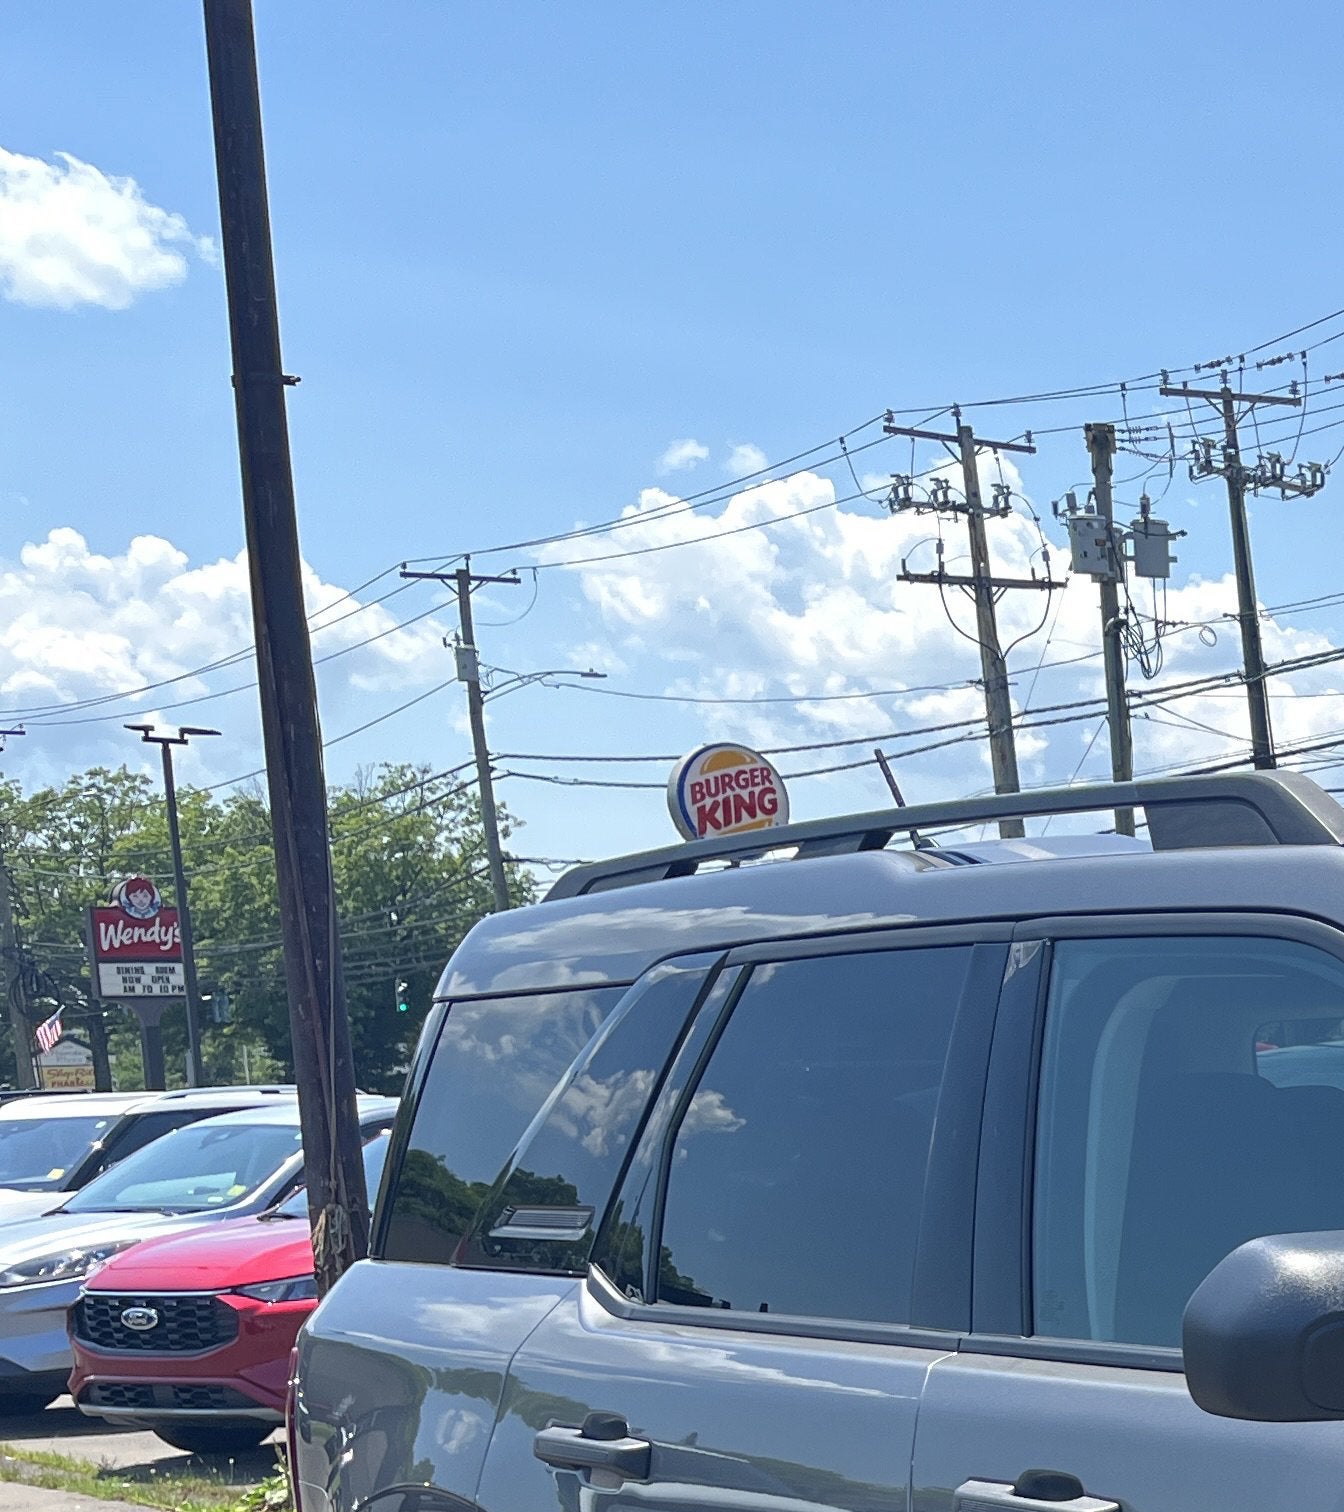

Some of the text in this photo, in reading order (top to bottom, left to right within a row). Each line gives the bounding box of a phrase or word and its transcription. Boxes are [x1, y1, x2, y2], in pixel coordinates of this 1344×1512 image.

[690, 767, 773, 806] BURGER
[697, 787, 778, 837] KING
[100, 917, 181, 951] Wendy's
[116, 966, 144, 975] DINING
[122, 975, 170, 984] NOW OPEN
[123, 985, 136, 993] AM
[142, 985, 153, 993] TO
